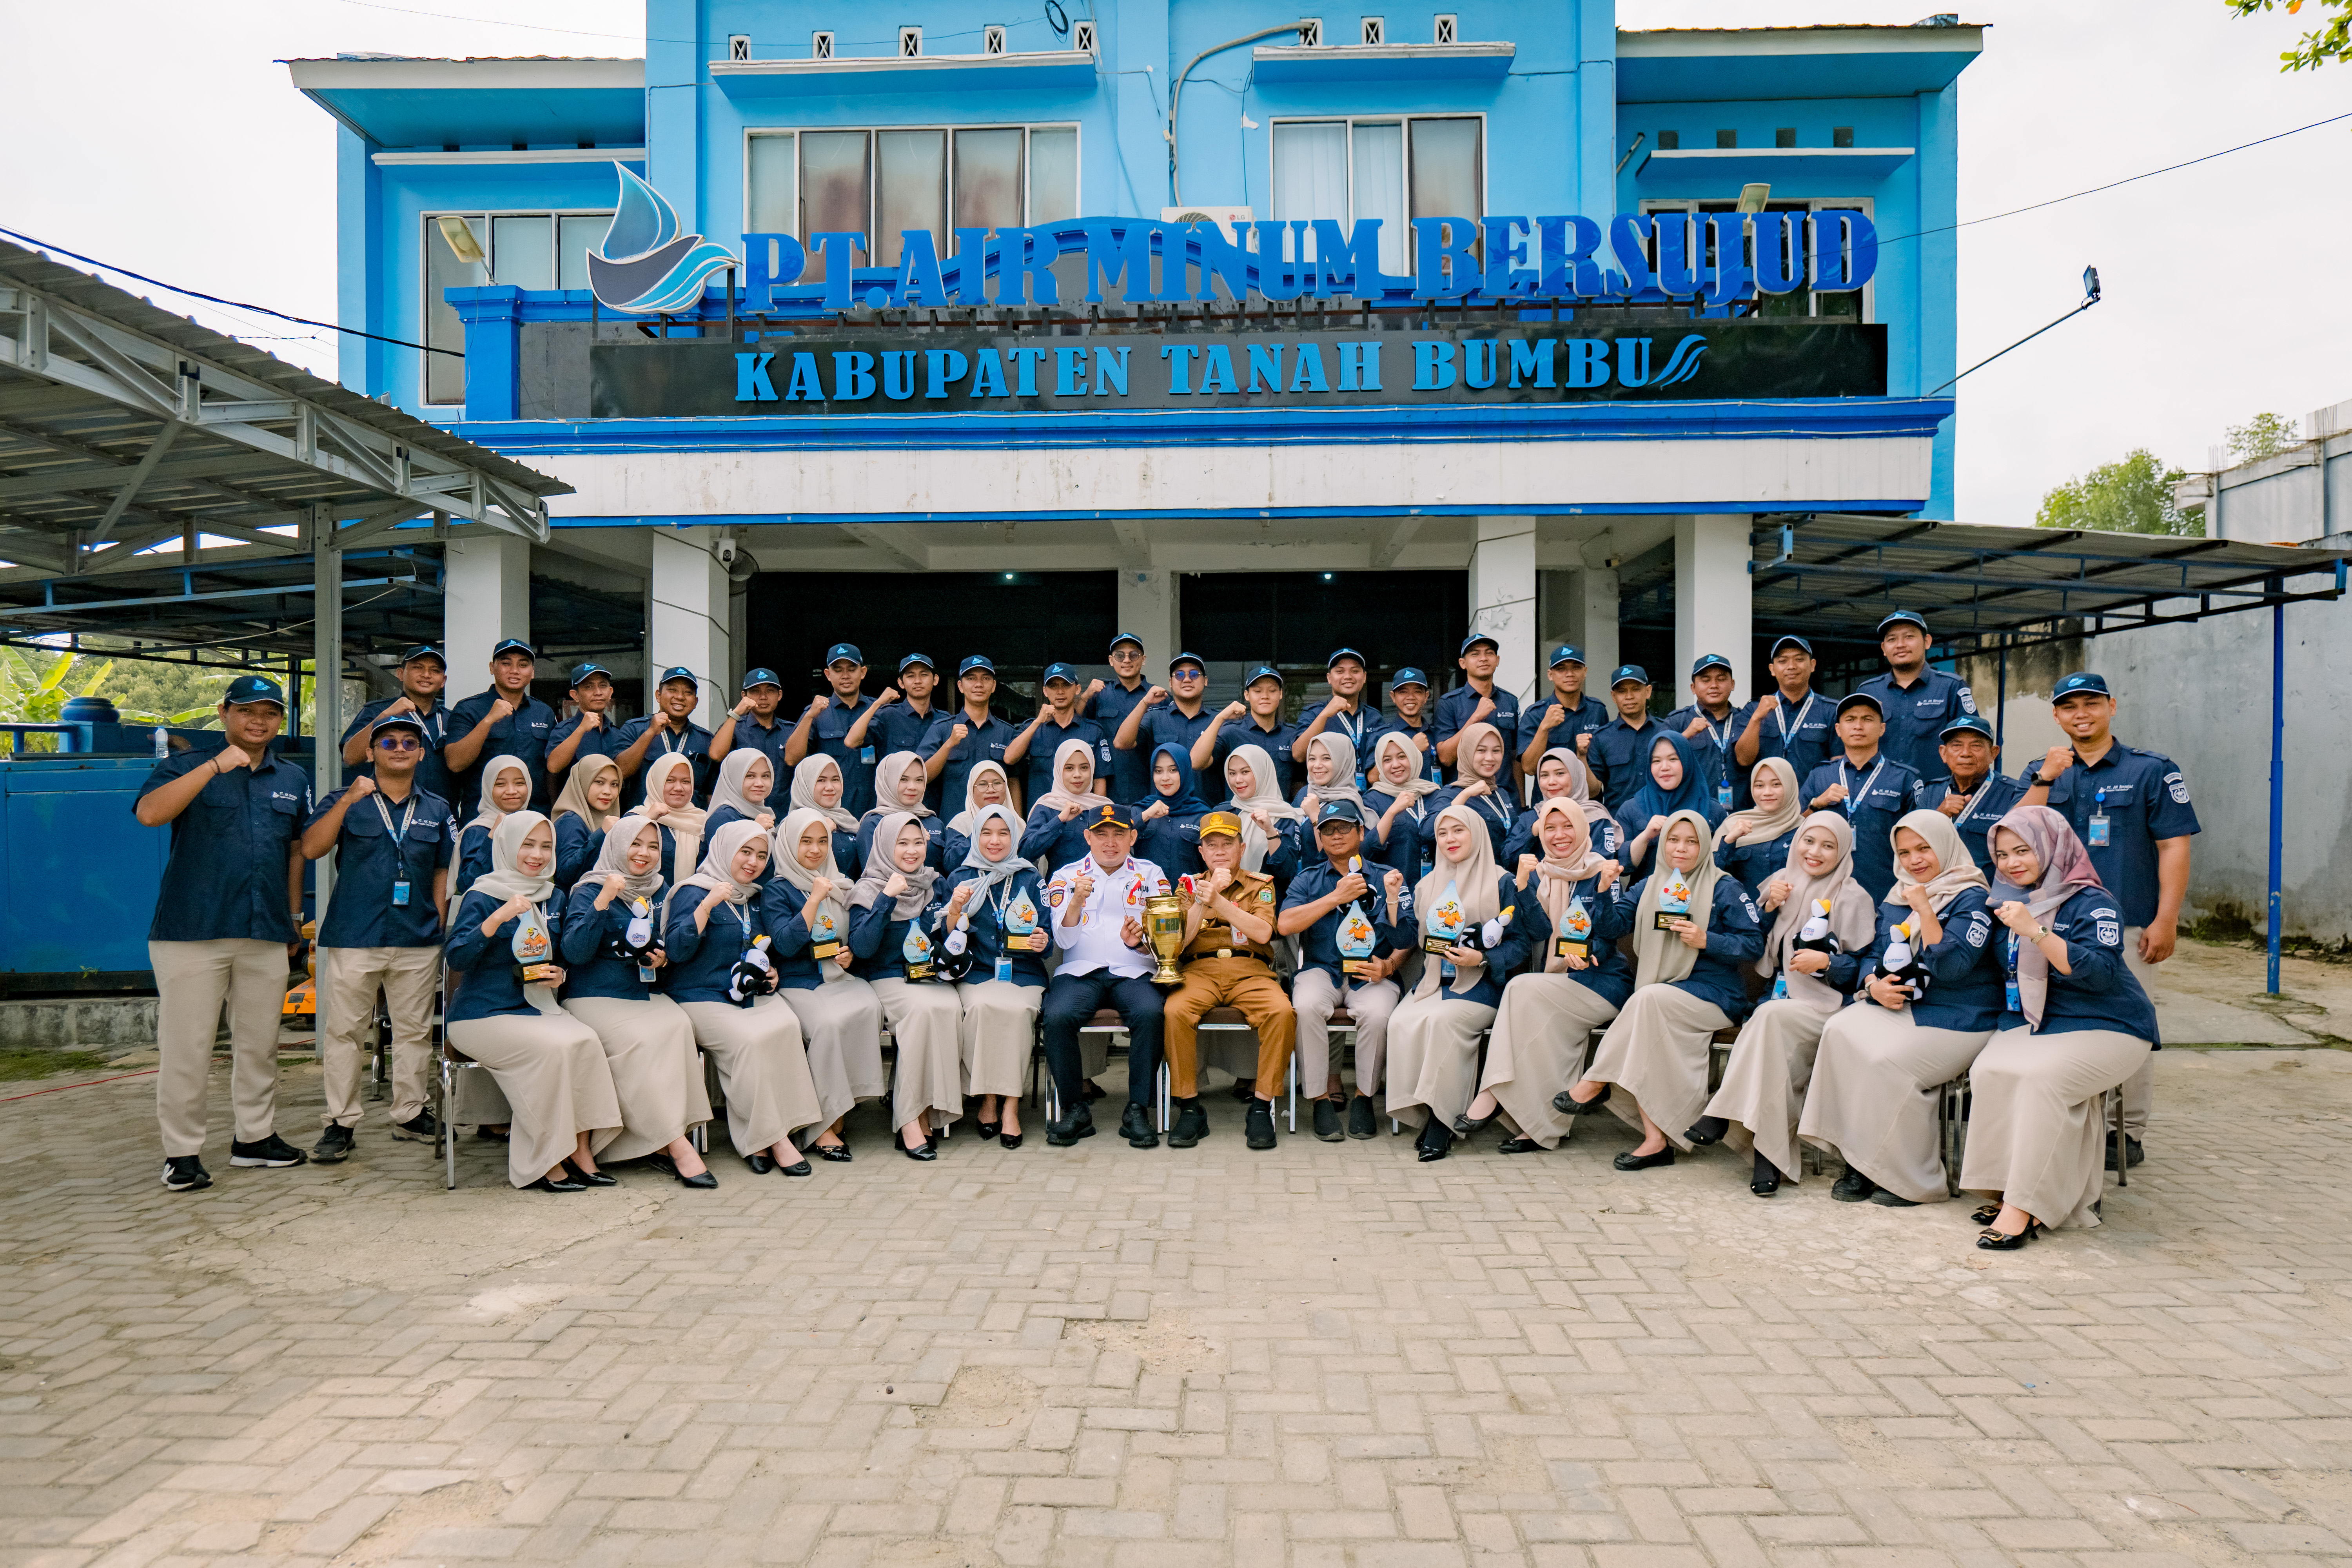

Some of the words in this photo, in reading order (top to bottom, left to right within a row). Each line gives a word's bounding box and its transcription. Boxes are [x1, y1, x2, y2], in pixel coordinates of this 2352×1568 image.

[1086, 219, 1383, 306] MINUM
[1411, 209, 1878, 308] BERSUJUD
[734, 347, 1131, 401] KABUPATEN
[1161, 341, 1383, 395] TANAH
[1412, 337, 1653, 391] BUMBU
